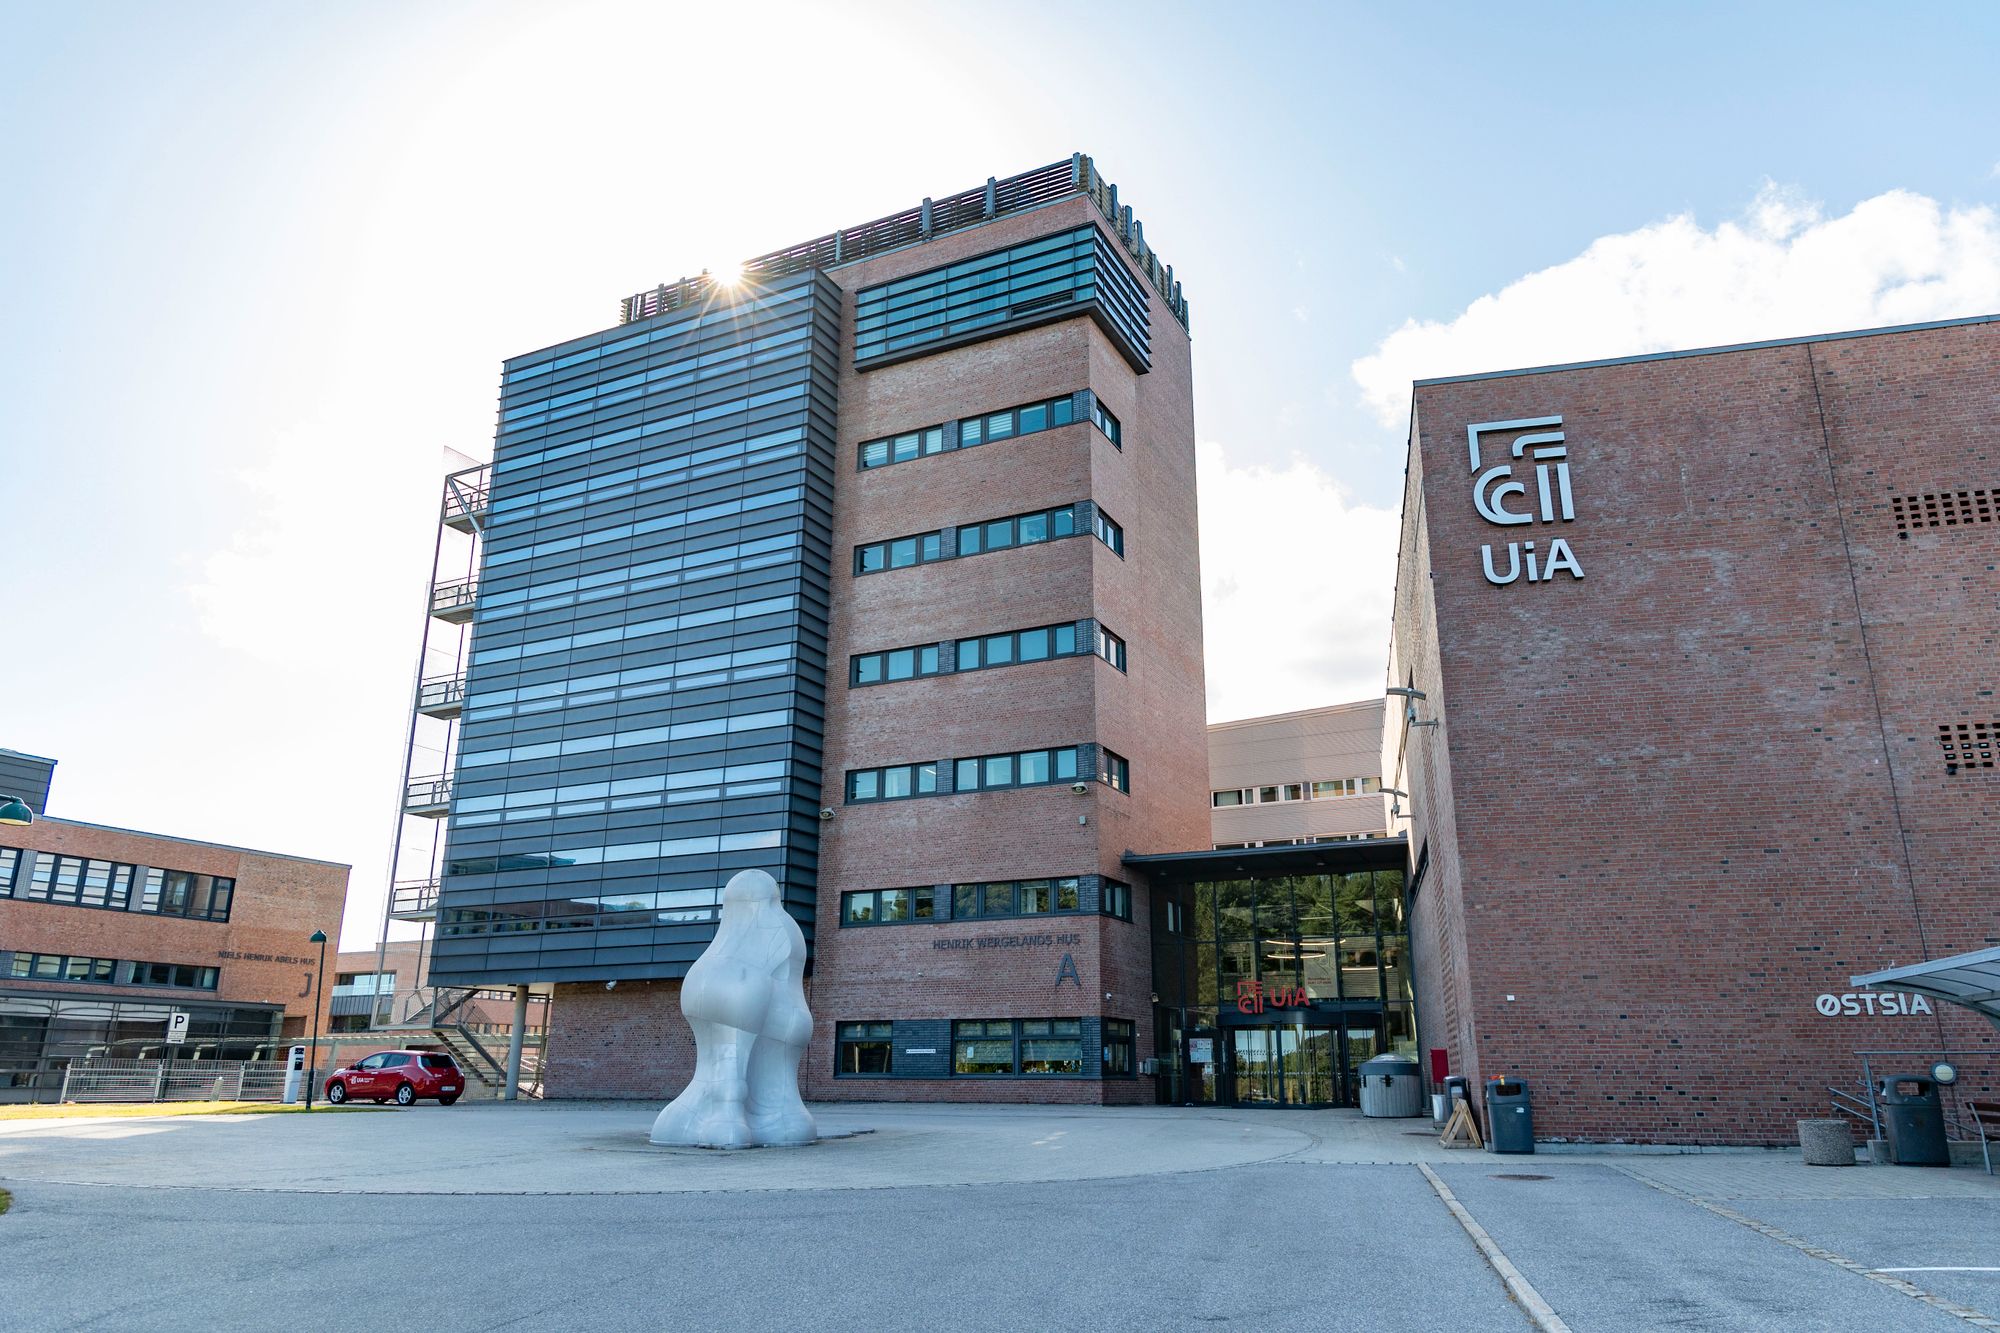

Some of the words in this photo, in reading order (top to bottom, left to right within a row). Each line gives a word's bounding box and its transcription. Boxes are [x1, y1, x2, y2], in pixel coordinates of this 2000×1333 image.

[1481, 538, 1585, 585] UiA
[933, 938, 974, 950] HENRIK
[977, 935, 1052, 948] WERGELANDS
[1056, 933, 1080, 945] HUS
[218, 950, 241, 959] NIELS
[243, 952, 273, 962] HENRIK
[275, 956, 298, 965] ABELS
[300, 957, 315, 966] HUS
[1055, 952, 1081, 987] A
[298, 972, 313, 998] J
[1269, 986, 1310, 1007] UiA
[1815, 992, 1933, 1017] ØSTSIA
[174, 1015, 185, 1029] P
